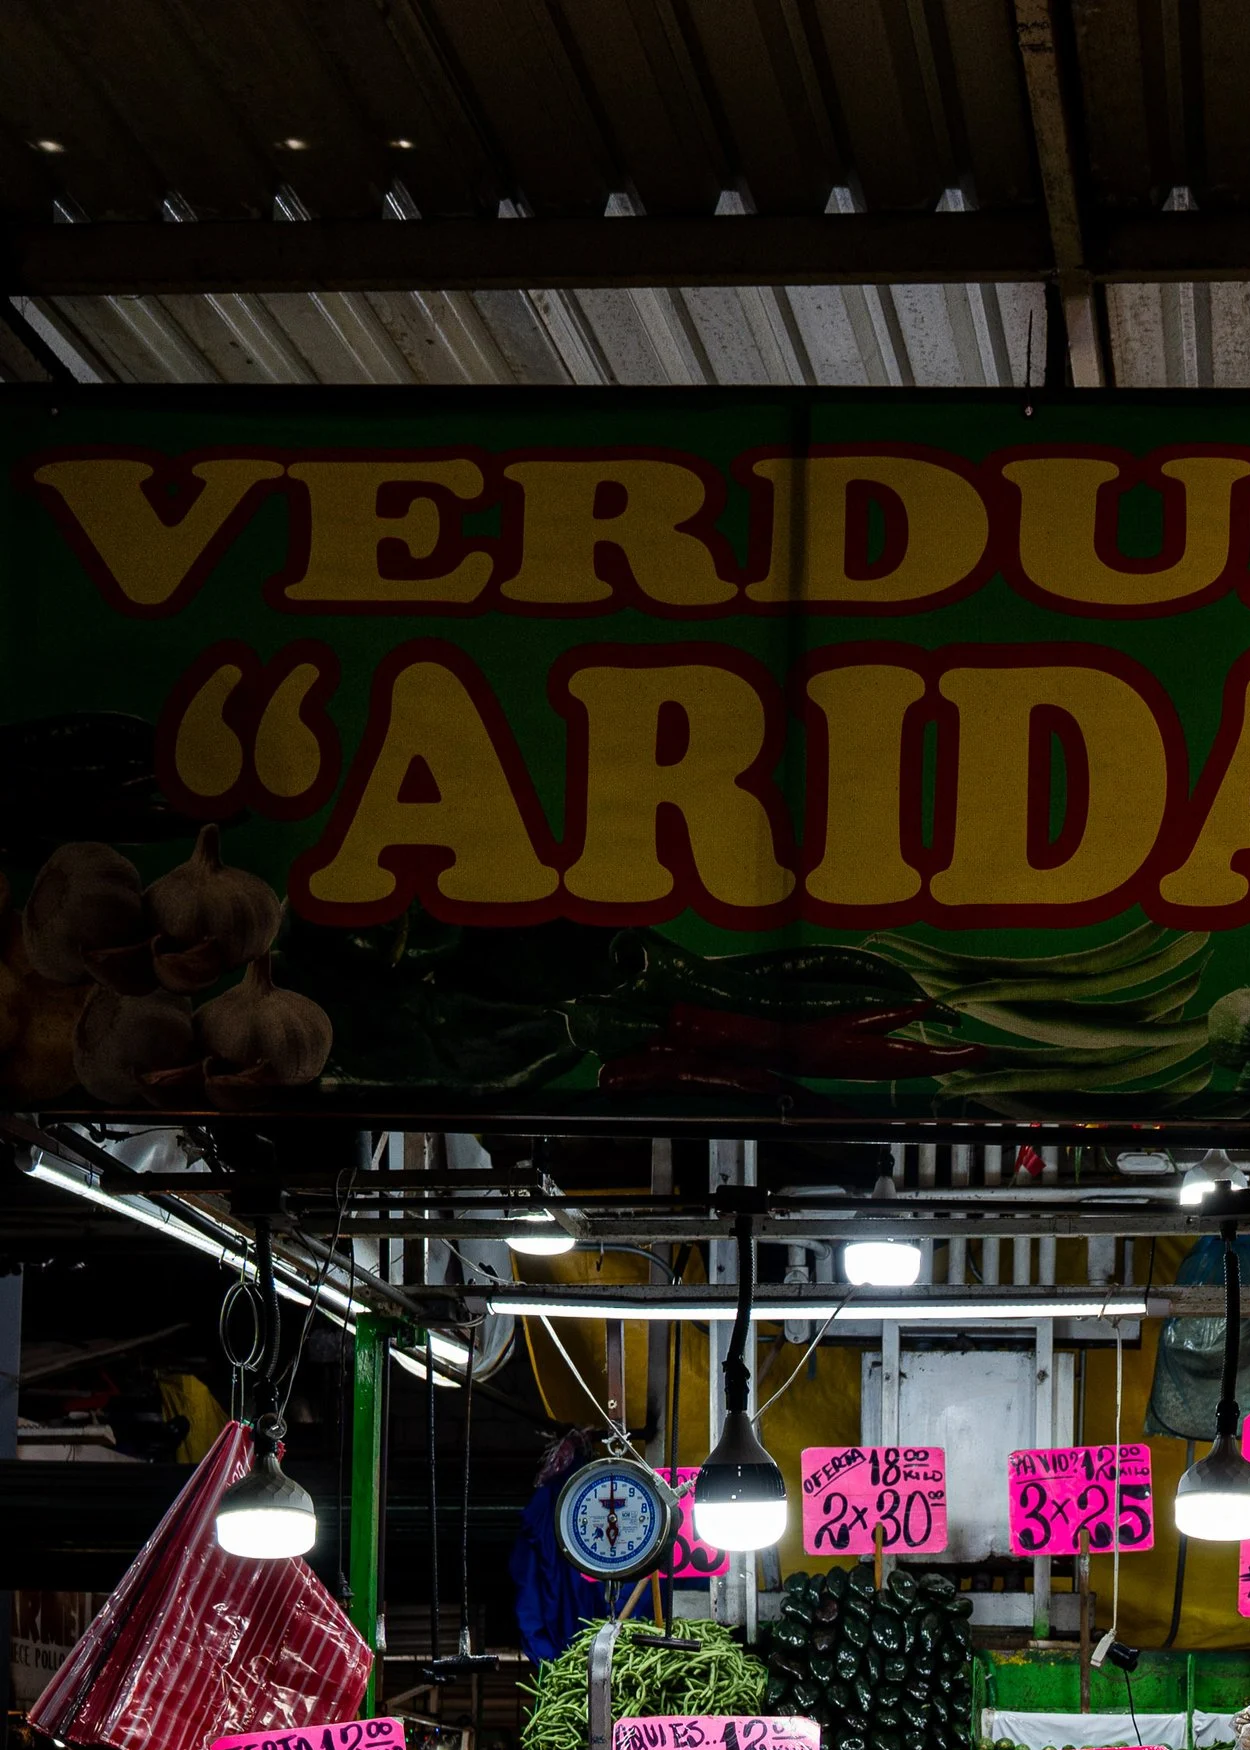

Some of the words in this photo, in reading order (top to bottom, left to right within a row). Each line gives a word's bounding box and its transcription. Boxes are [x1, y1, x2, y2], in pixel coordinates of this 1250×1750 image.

[1011, 1453, 1036, 1477] YA
[1080, 1447, 1117, 1481] 12
[804, 1448, 866, 1493] OFERTA
[869, 1447, 901, 1486] 18
[903, 1449, 930, 1462] 00
[1118, 1466, 1150, 1476] KILO
[903, 1470, 943, 1482] KILO
[594, 1488, 598, 1498] 1
[628, 1487, 636, 1498] 9
[581, 1505, 588, 1515] 2
[640, 1502, 648, 1513] 8
[580, 1525, 587, 1535] 3
[643, 1525, 648, 1535] 7
[590, 1542, 597, 1552] 4
[627, 1541, 634, 1551] 6
[610, 1547, 617, 1557] 5
[366, 1721, 393, 1737] 00
